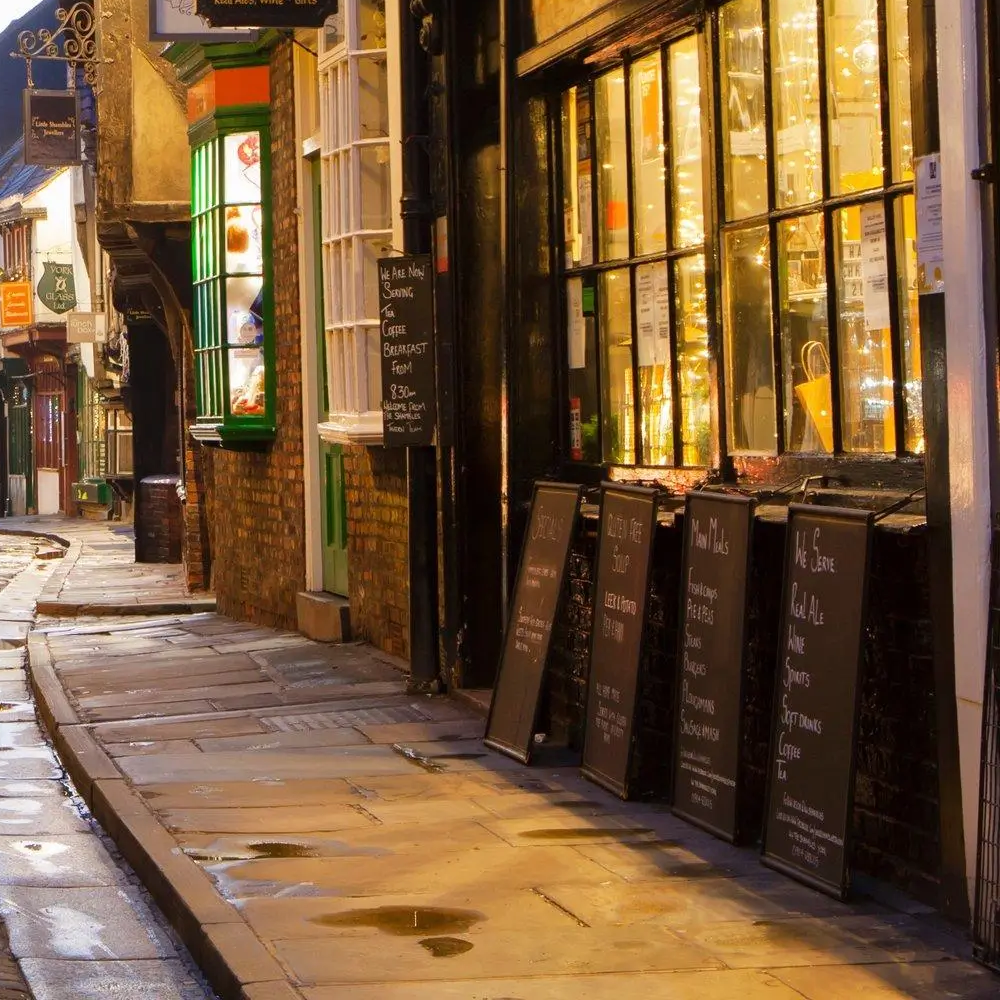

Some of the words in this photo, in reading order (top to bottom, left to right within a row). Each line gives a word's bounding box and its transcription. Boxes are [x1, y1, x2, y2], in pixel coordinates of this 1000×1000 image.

[50, 266, 73, 275] YORK
[380, 266, 390, 280] WE
[392, 266, 407, 280] ARE
[408, 262, 426, 280] NOW
[45, 293, 75, 301] GLASS
[382, 281, 414, 299] SERVING
[380, 303, 395, 318] TEA
[381, 319, 407, 338] COFFEE
[383, 341, 429, 358] BREAKFAST
[391, 360, 413, 375] FROM
[795, 530, 807, 569] WE
[810, 527, 835, 573] SERVE
[790, 582, 806, 619] REAL
[808, 594, 825, 625] ALE
[788, 623, 806, 655] WINE
[781, 694, 799, 732] SOFT
[799, 712, 822, 735] DRINKS
[779, 731, 801, 760] COFFEE
[776, 759, 787, 781] TEA
